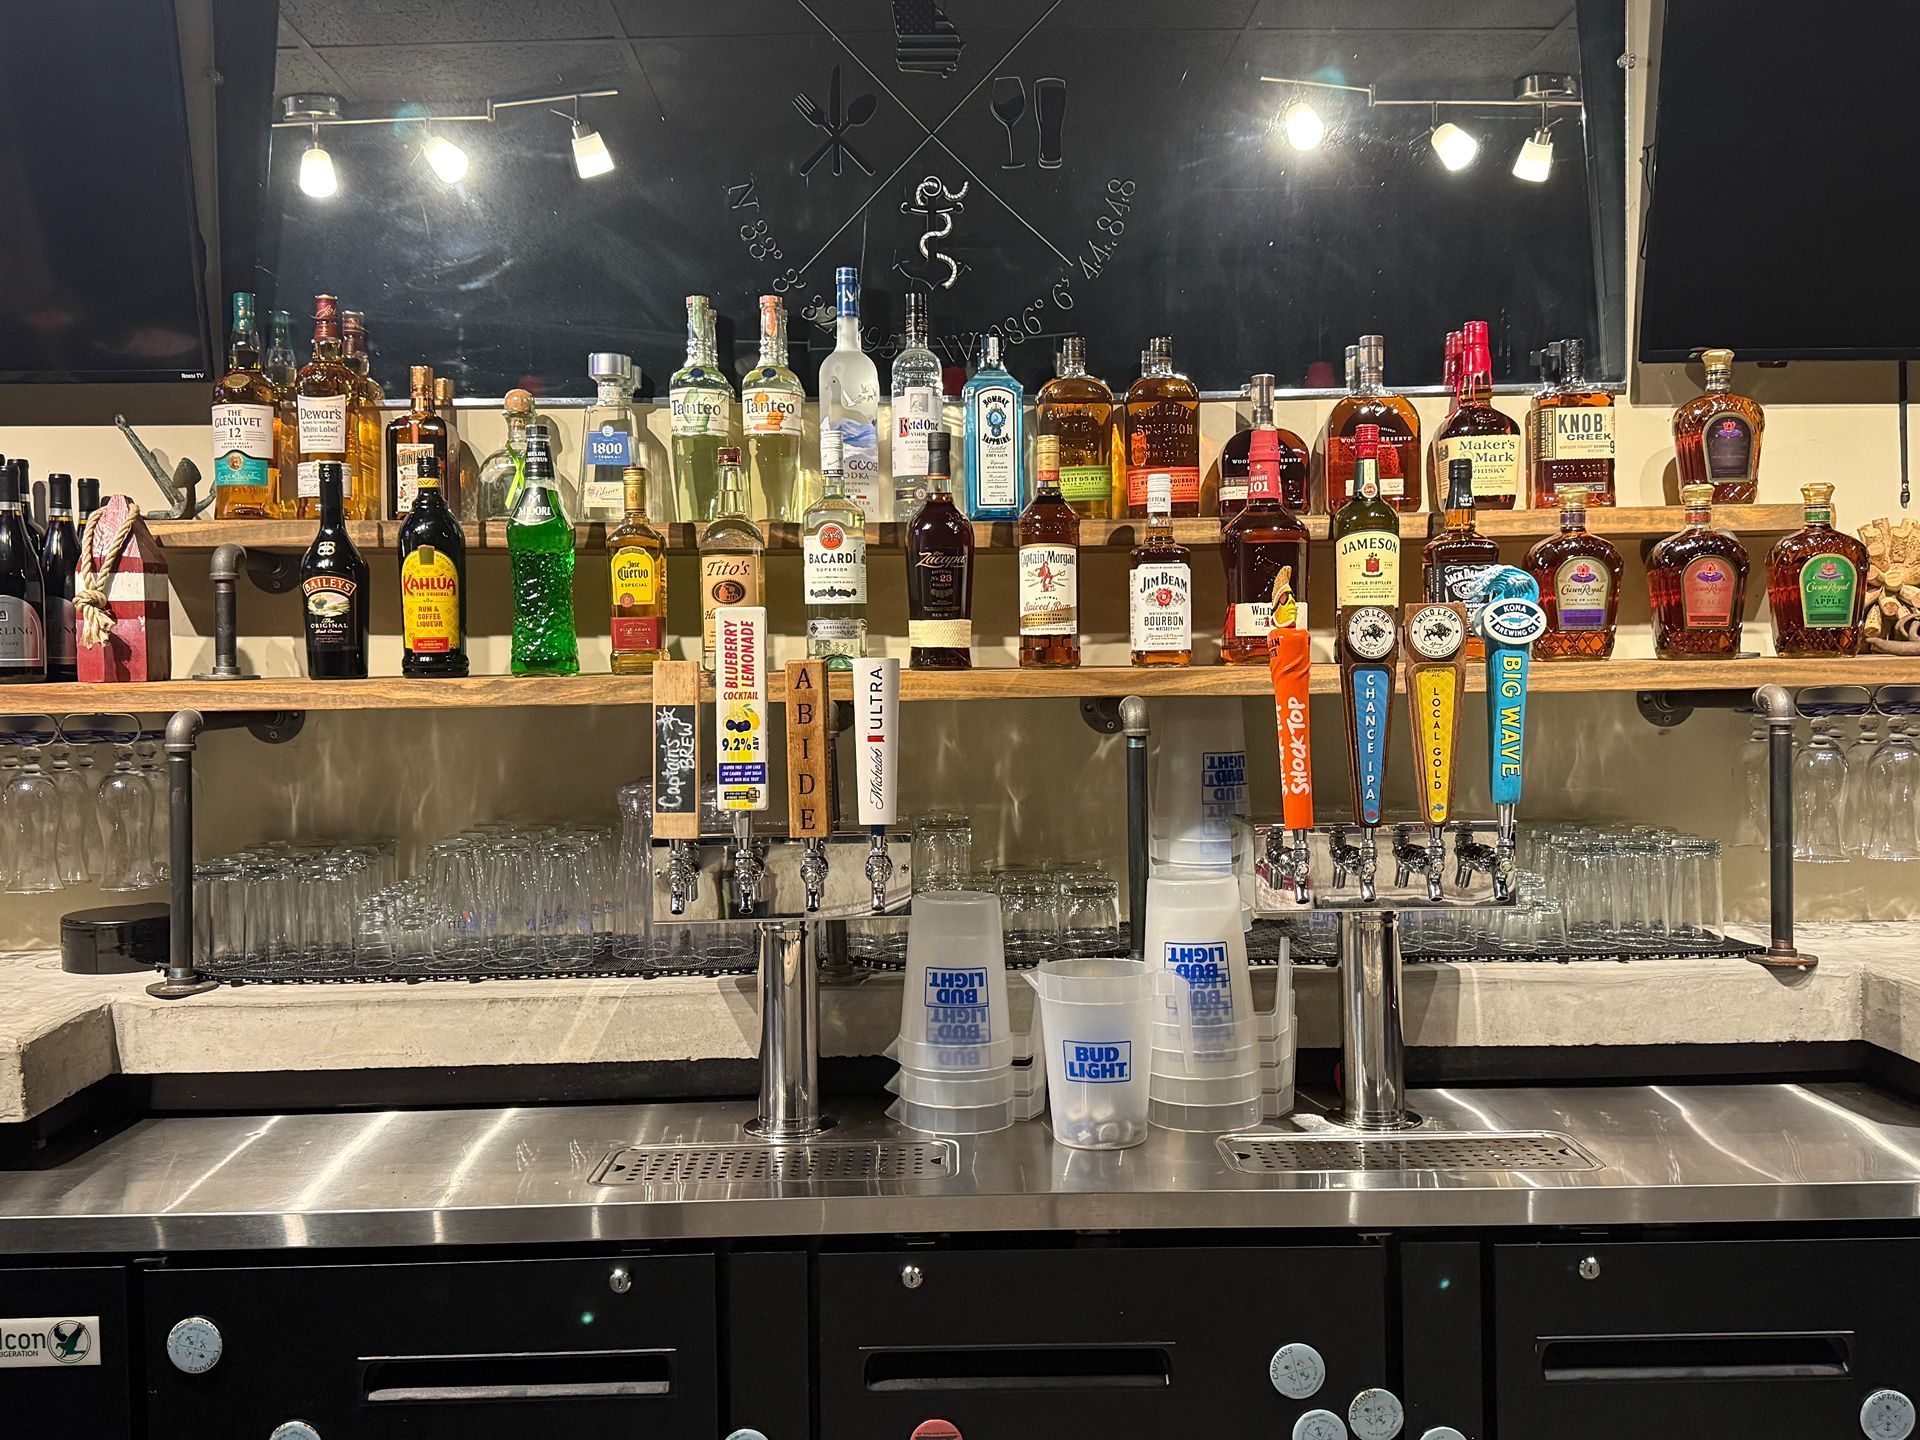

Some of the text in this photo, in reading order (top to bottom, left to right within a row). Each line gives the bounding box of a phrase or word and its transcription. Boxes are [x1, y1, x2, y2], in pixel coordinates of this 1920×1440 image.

[671, 399, 721, 416] Tanteo
[745, 398, 795, 414] Tanteo
[982, 395, 1010, 408] BOMBAY
[300, 408, 342, 420] Dewar's
[214, 418, 262, 428] GLENLIVET
[899, 417, 939, 437] Ketel One
[1558, 413, 1604, 434] KNOB
[229, 427, 241, 438] 12
[982, 433, 1011, 445] SAPPHIRE
[1567, 433, 1612, 441] CREEK
[592, 442, 623, 455] 1800
[1459, 440, 1516, 451] Maker's
[1610, 440, 1616, 454] 9
[1475, 452, 1515, 462] Mark
[844, 472, 870, 480] ODKA
[1249, 481, 1270, 493] 101
[518, 506, 552, 517] MIDORI
[1342, 537, 1398, 556] JAMESON
[809, 549, 857, 564] BACARDÍ
[915, 551, 968, 568] Zacapa
[1021, 550, 1076, 570] Captain Morgan
[626, 560, 640, 569] Jose
[617, 565, 649, 581] Cuervo
[940, 574, 952, 582] 23
[1444, 570, 1464, 587] JACK
[304, 578, 351, 593] BAILEYS
[403, 573, 457, 596] KAHLÚA
[1140, 571, 1188, 594] JIM BEAM
[1560, 583, 1605, 596] Crown Royal
[1806, 581, 1850, 593] Crown Royal
[1023, 601, 1071, 612] Spiced Rum
[1503, 604, 1527, 613] KONA
[1144, 616, 1184, 626] BOURBON
[1352, 609, 1391, 625] WILD LEAP
[1415, 608, 1458, 623] WILD LEAP
[1494, 624, 1528, 637] BREWING
[724, 620, 738, 689] BLUEBERRY
[741, 620, 755, 688] LEMONADE
[1357, 646, 1375, 656] BREW
[1420, 644, 1440, 655] BREW
[723, 691, 759, 700] COCKTAIL
[870, 666, 883, 730] ULTRA
[1500, 655, 1523, 778] BIG WAVE
[722, 737, 752, 751] 9.2%
[1365, 674, 1376, 800] CHANCE IPA
[1432, 687, 1442, 790] LOCAL GOLD
[679, 722, 695, 769] BREW
[795, 667, 815, 831] ABIDE
[1286, 696, 1310, 796] SHOCK TOP
[657, 736, 686, 808] Captain's
[869, 747, 884, 810] Michelob
[1175, 963, 1219, 980] BUD
[936, 988, 978, 1004] BUD
[938, 1024, 980, 1040] BUD
[1075, 1046, 1120, 1063] BUD
